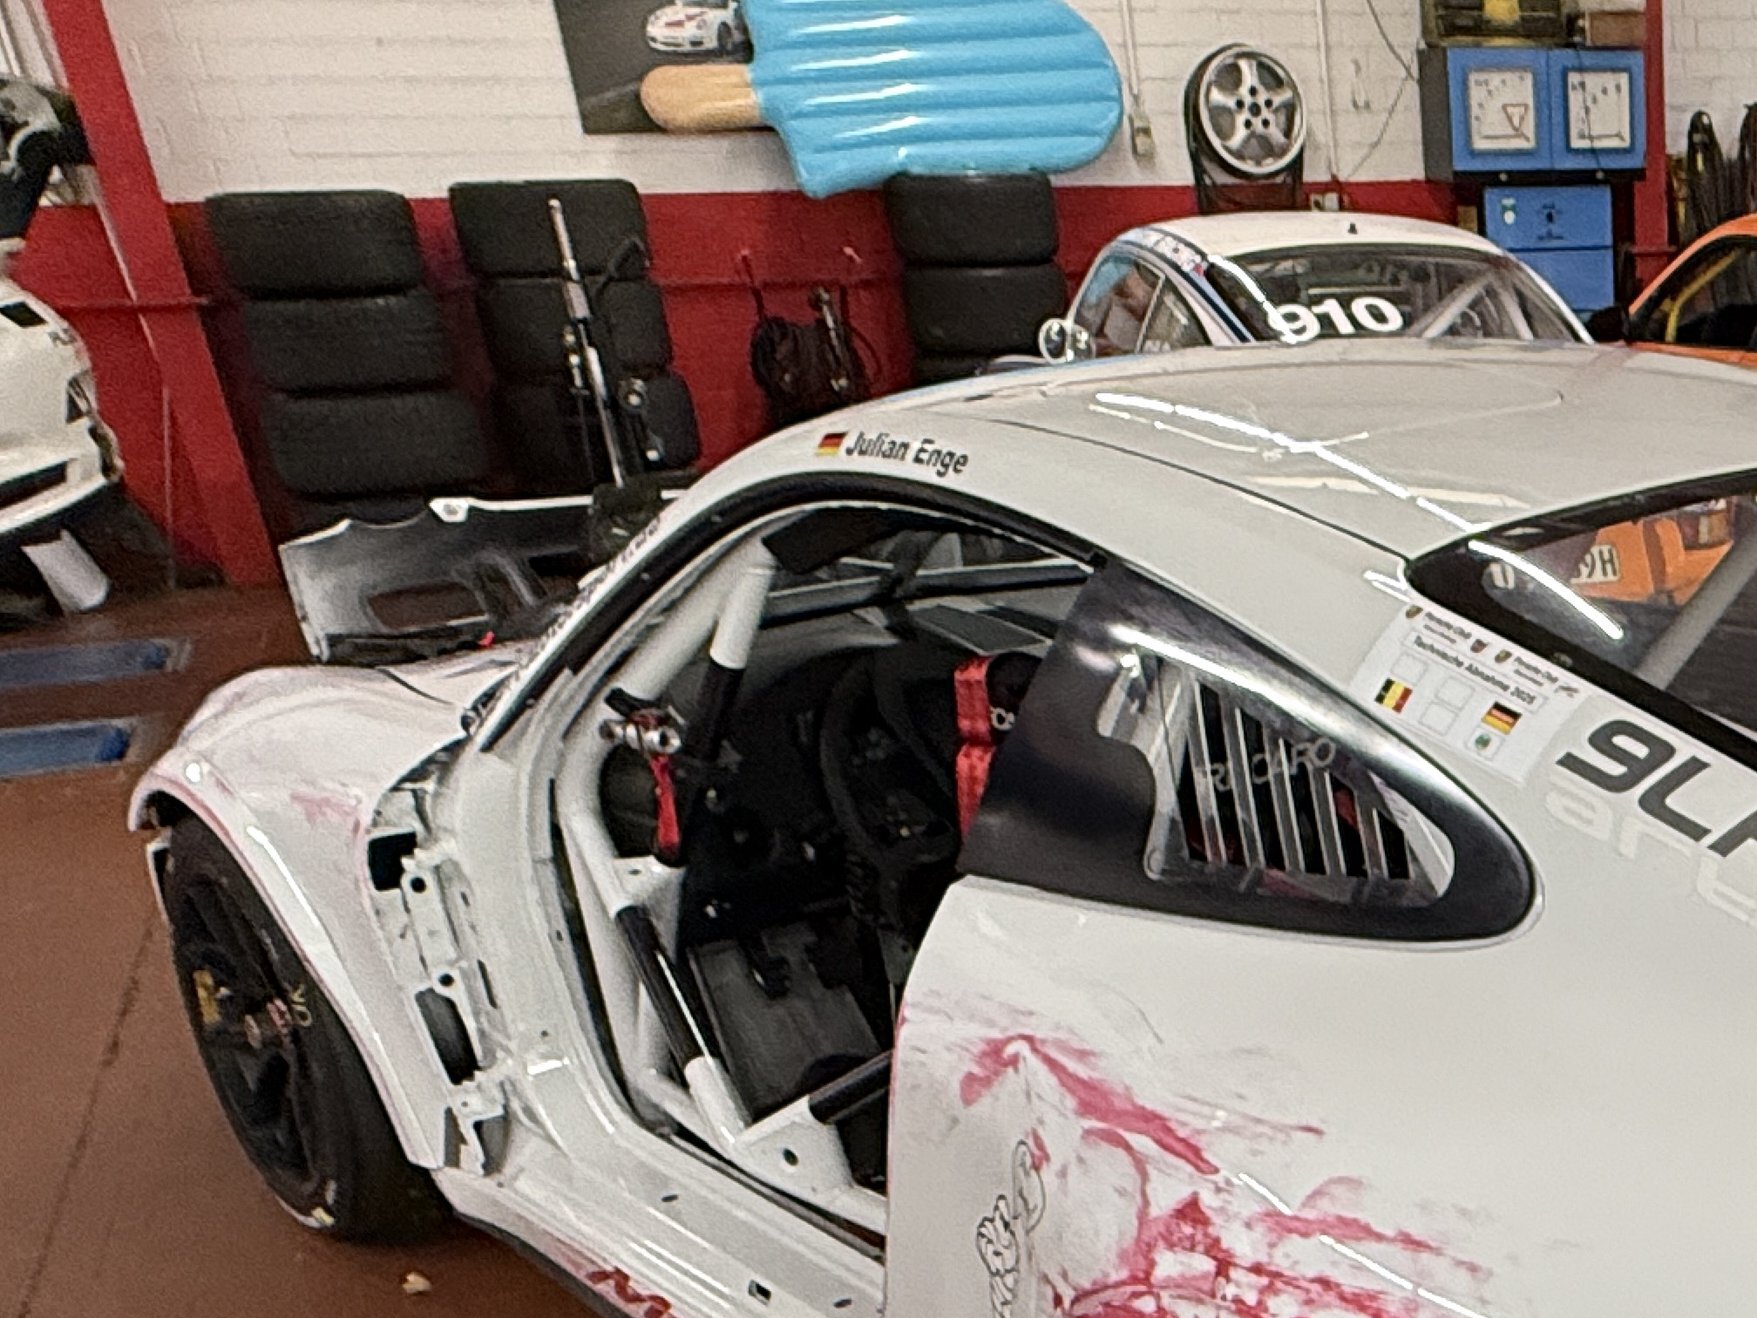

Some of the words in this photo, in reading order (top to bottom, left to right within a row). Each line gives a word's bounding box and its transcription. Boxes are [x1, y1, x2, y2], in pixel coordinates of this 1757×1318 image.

[1267, 296, 1404, 345] 910
[845, 430, 910, 462] Julian
[912, 438, 969, 478] Enge
